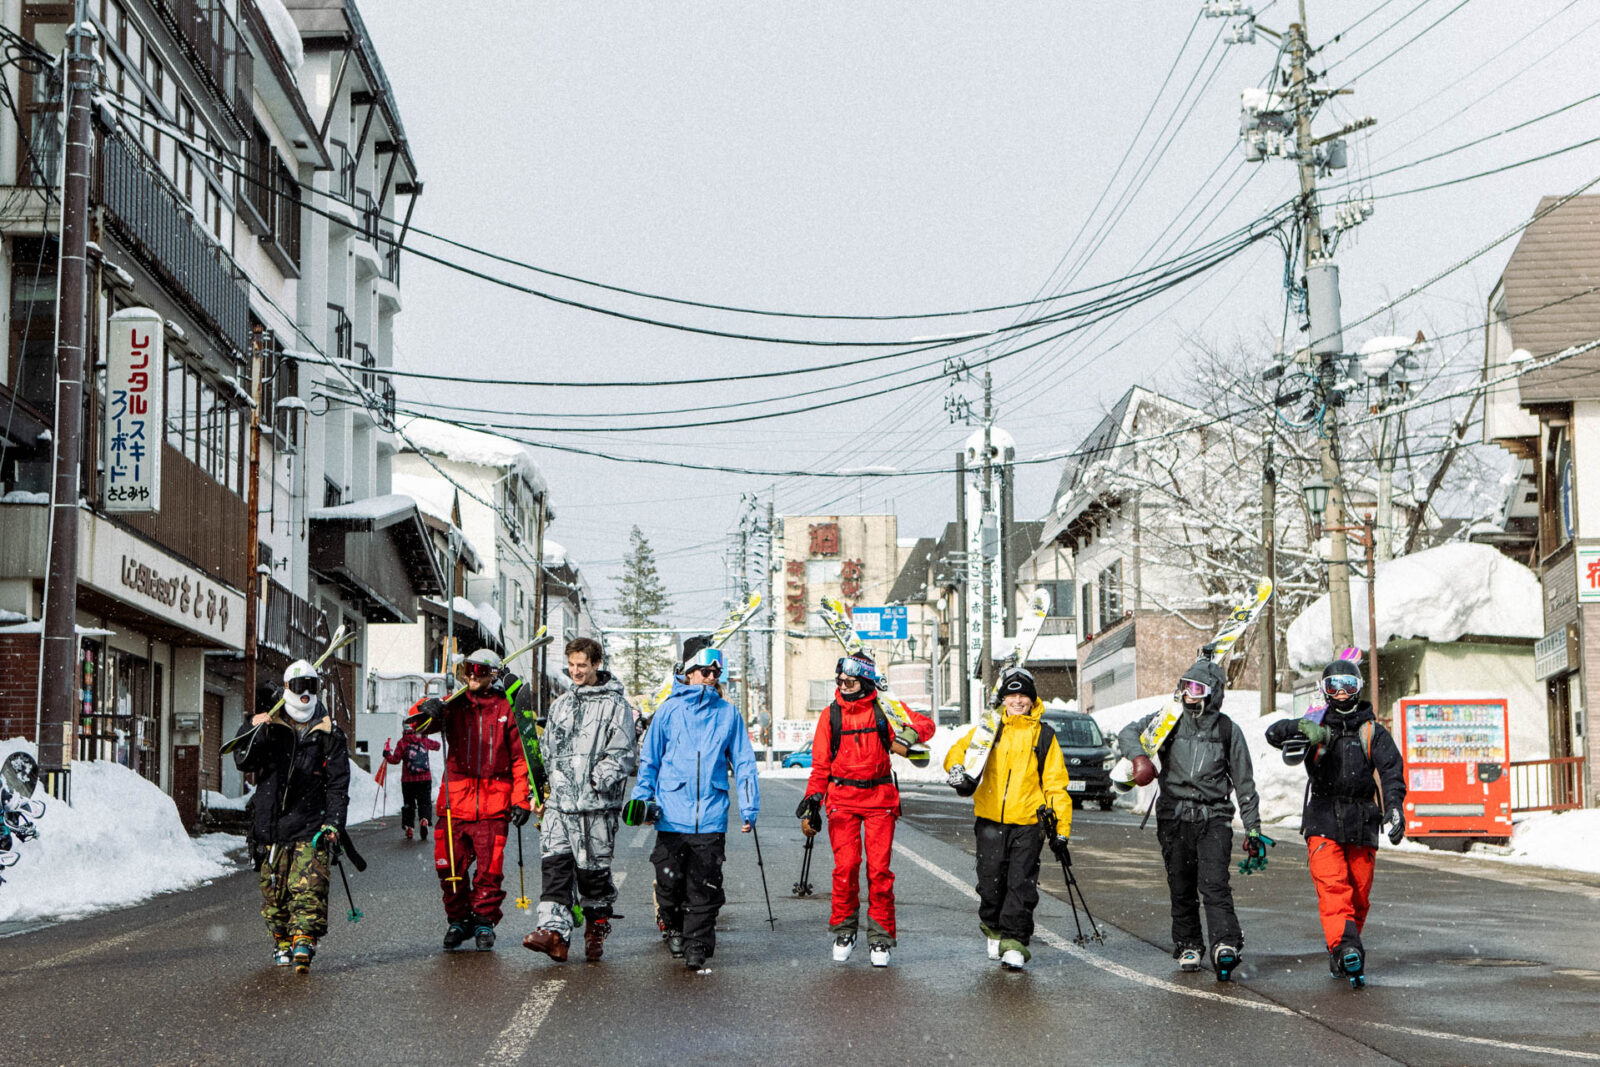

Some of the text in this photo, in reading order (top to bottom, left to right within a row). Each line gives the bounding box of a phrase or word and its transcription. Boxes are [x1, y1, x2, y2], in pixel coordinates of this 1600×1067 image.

[111, 390, 129, 484] スノーボード
[128, 328, 149, 482] レンタル スキー
[107, 486, 150, 501] さとみや
